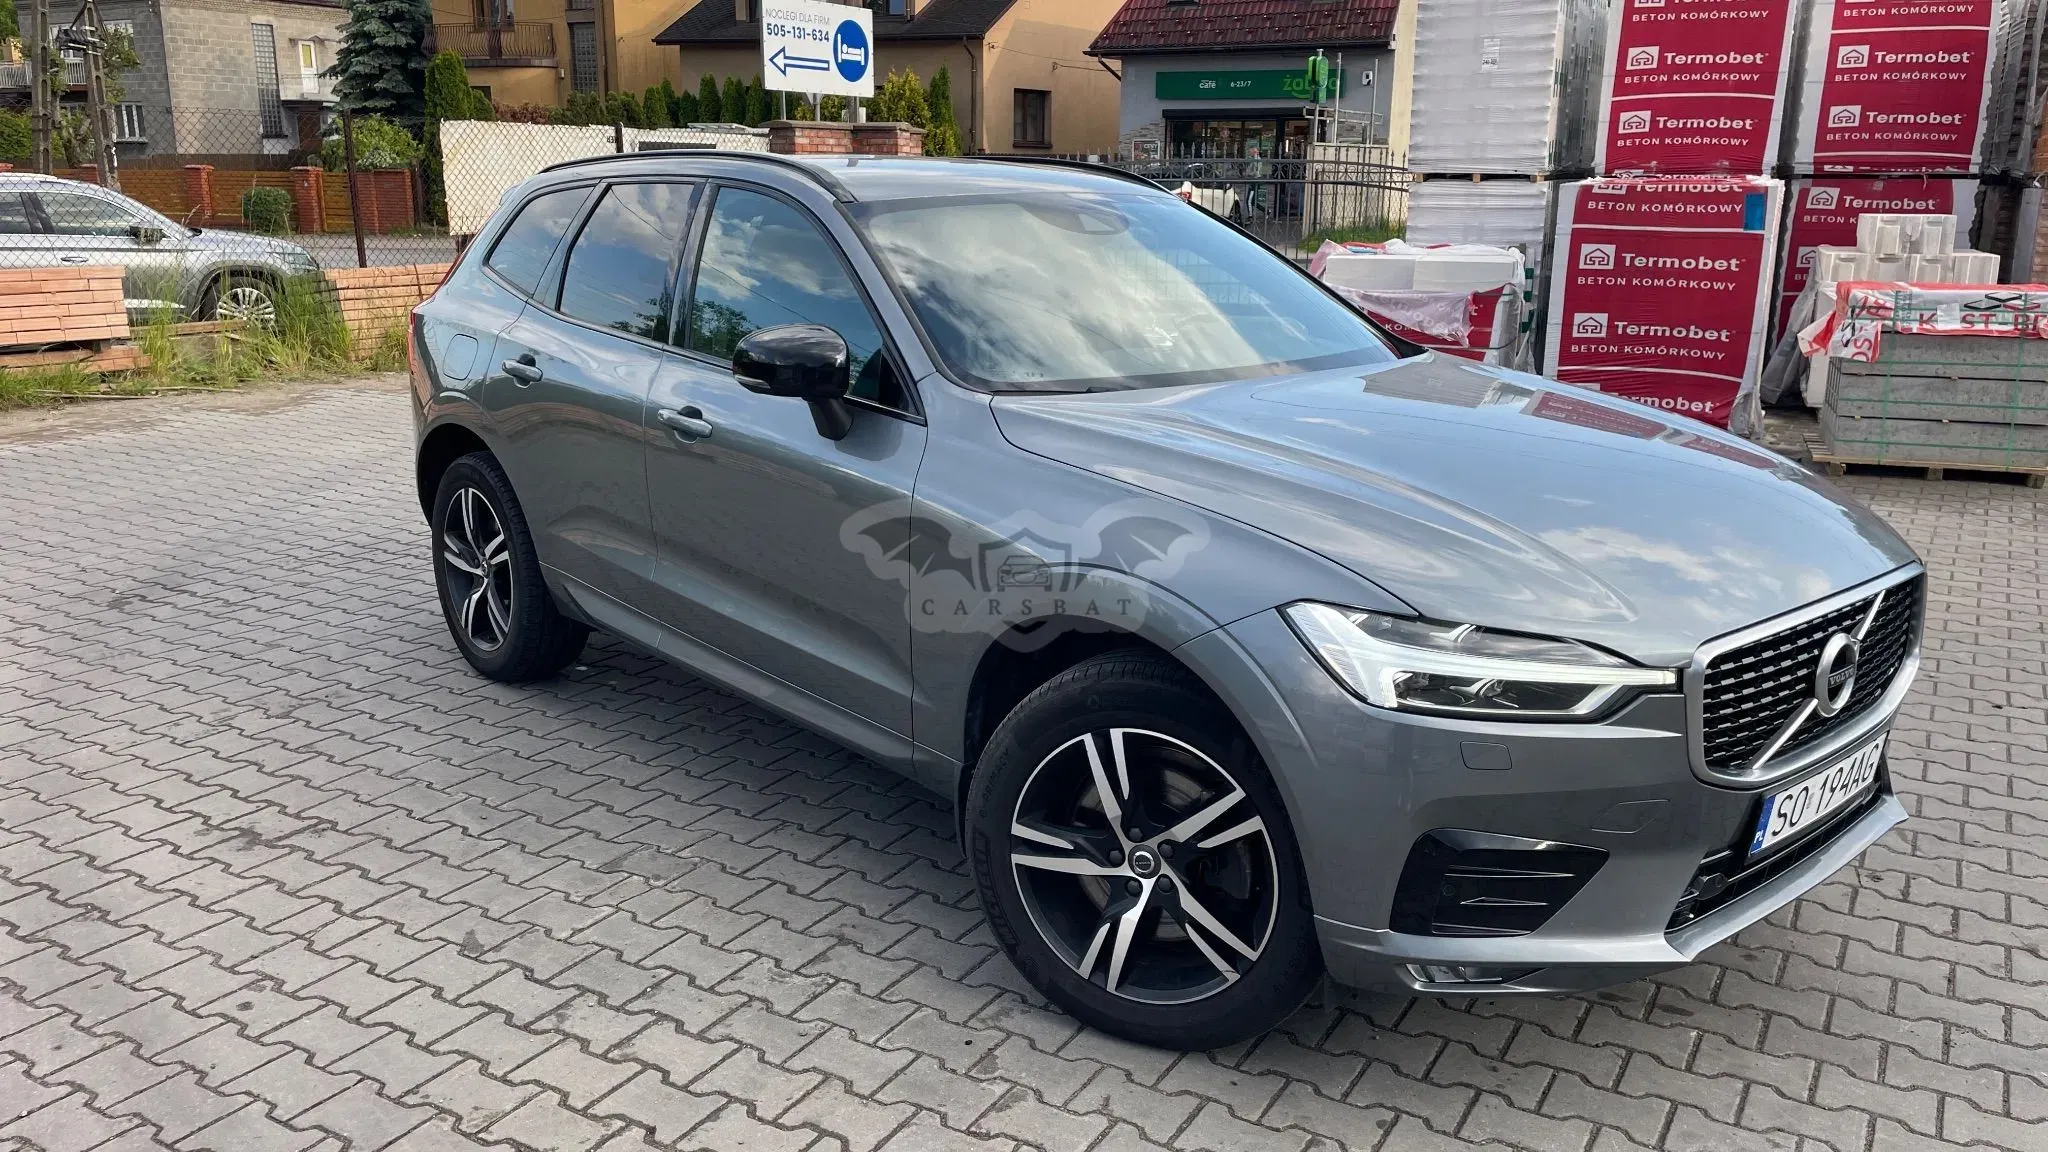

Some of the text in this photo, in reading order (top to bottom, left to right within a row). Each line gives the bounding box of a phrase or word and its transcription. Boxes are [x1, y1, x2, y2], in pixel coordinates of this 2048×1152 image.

[1633, 10, 1768, 22] BETON KOMÓRKOWY
[1891, 5, 1973, 15] KOMÓRKOWY
[766, 9, 830, 25] NOCLEGI DLA FIRM
[767, 23, 829, 42] 505-131-634
[1625, 72, 1760, 83] BETON KOMÓRKOWY
[1835, 71, 1966, 81] BETON KOMÓRKOWY
[1617, 136, 1749, 146] BETON KOMÓRKOWY
[1827, 131, 1957, 141] BETON KOMÓRKOWY
[1588, 201, 1742, 213] BETON KOMÓRKOWY
[1803, 215, 1844, 223] BETON
[1578, 277, 1736, 291] BETON KOMÓRKOWY
[1571, 345, 1725, 360] BETON KOMÓRKOWY
[1772, 786, 1809, 836] SO
[1753, 829, 1764, 843] PL
